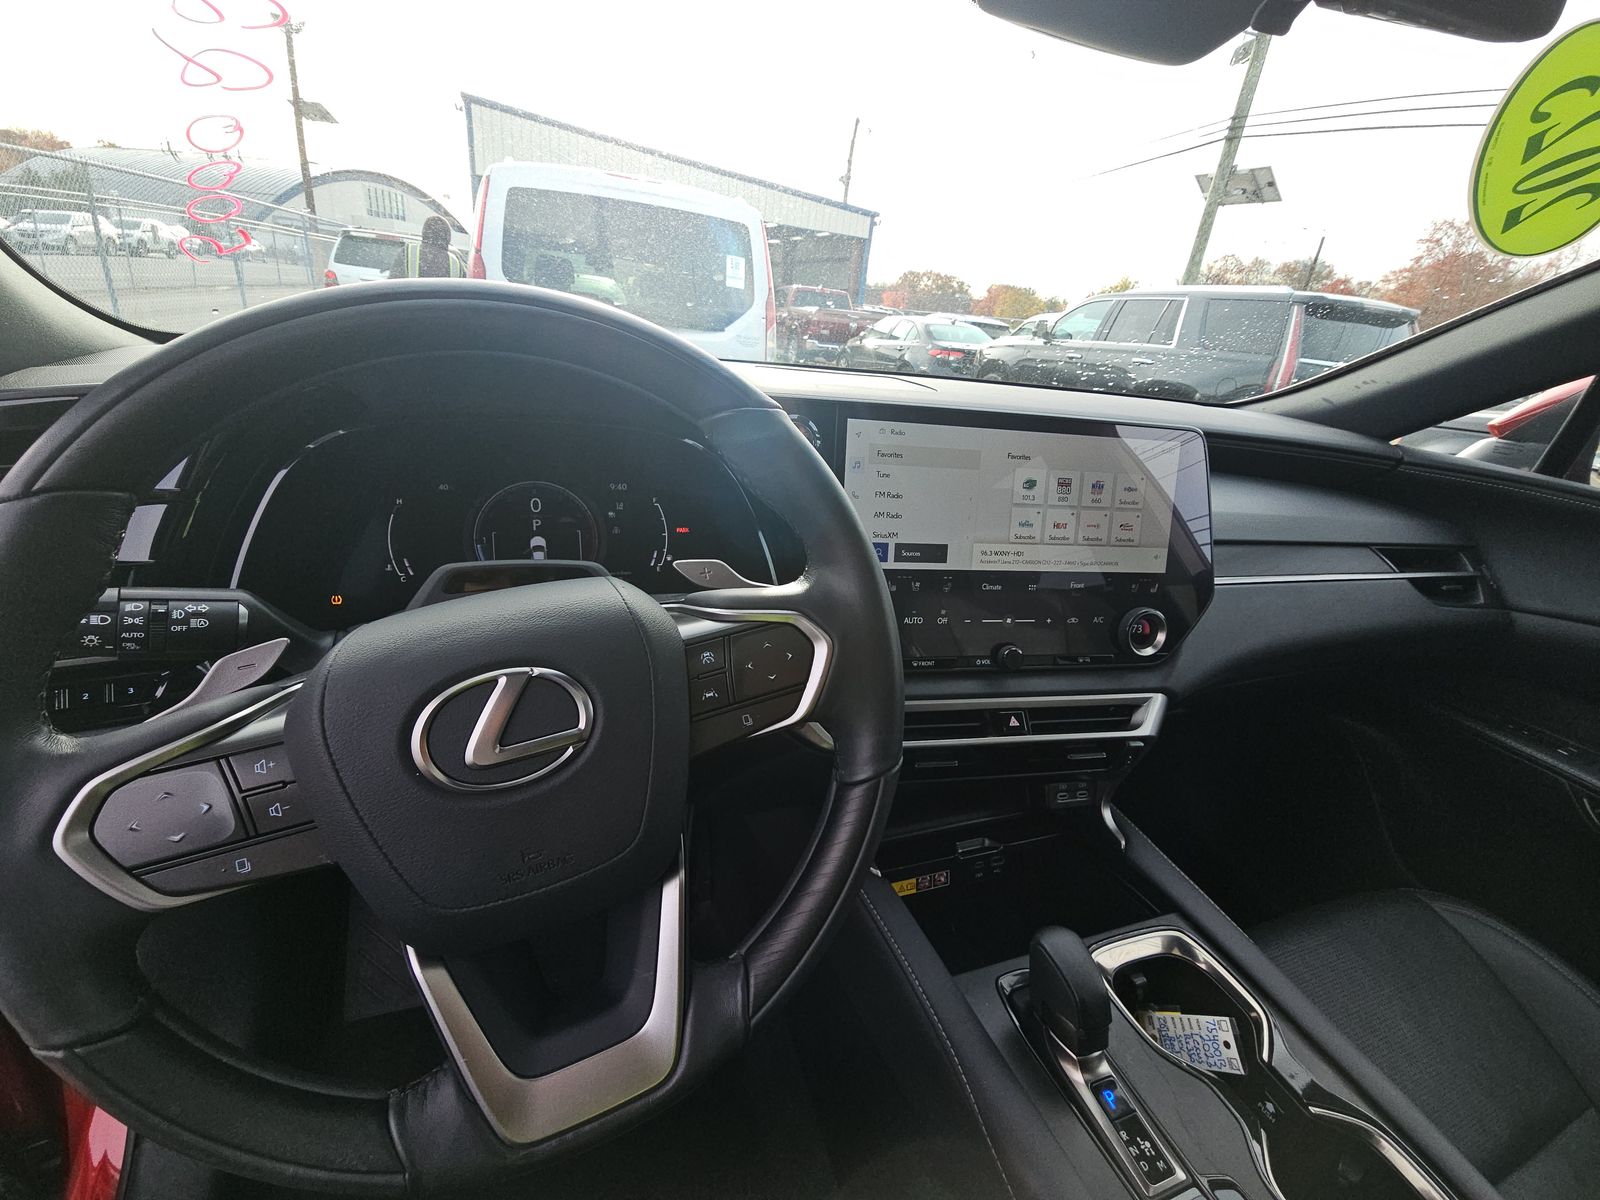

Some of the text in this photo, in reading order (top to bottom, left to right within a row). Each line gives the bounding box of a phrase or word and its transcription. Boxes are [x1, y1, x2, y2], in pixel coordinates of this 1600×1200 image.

[890, 428, 906, 436] Radio
[877, 450, 903, 459] Favorites
[1007, 453, 1031, 461] Favorites
[876, 471, 891, 479] Tune
[1056, 485, 1072, 495] 880
[874, 491, 903, 499] FM Radio
[532, 519, 542, 531] P
[1052, 521, 1068, 530] HEAT
[872, 531, 899, 539] SiriusXM
[981, 583, 1002, 591] Climate
[903, 616, 924, 625] AUTO
[937, 616, 949, 625] Off
[1092, 616, 1105, 624] A/C
[1132, 624, 1143, 634] 73
[1200, 1034, 1217, 1068] 2023
[1103, 1089, 1116, 1110] P
[1119, 1130, 1130, 1141] R
[1140, 1161, 1149, 1172] D
